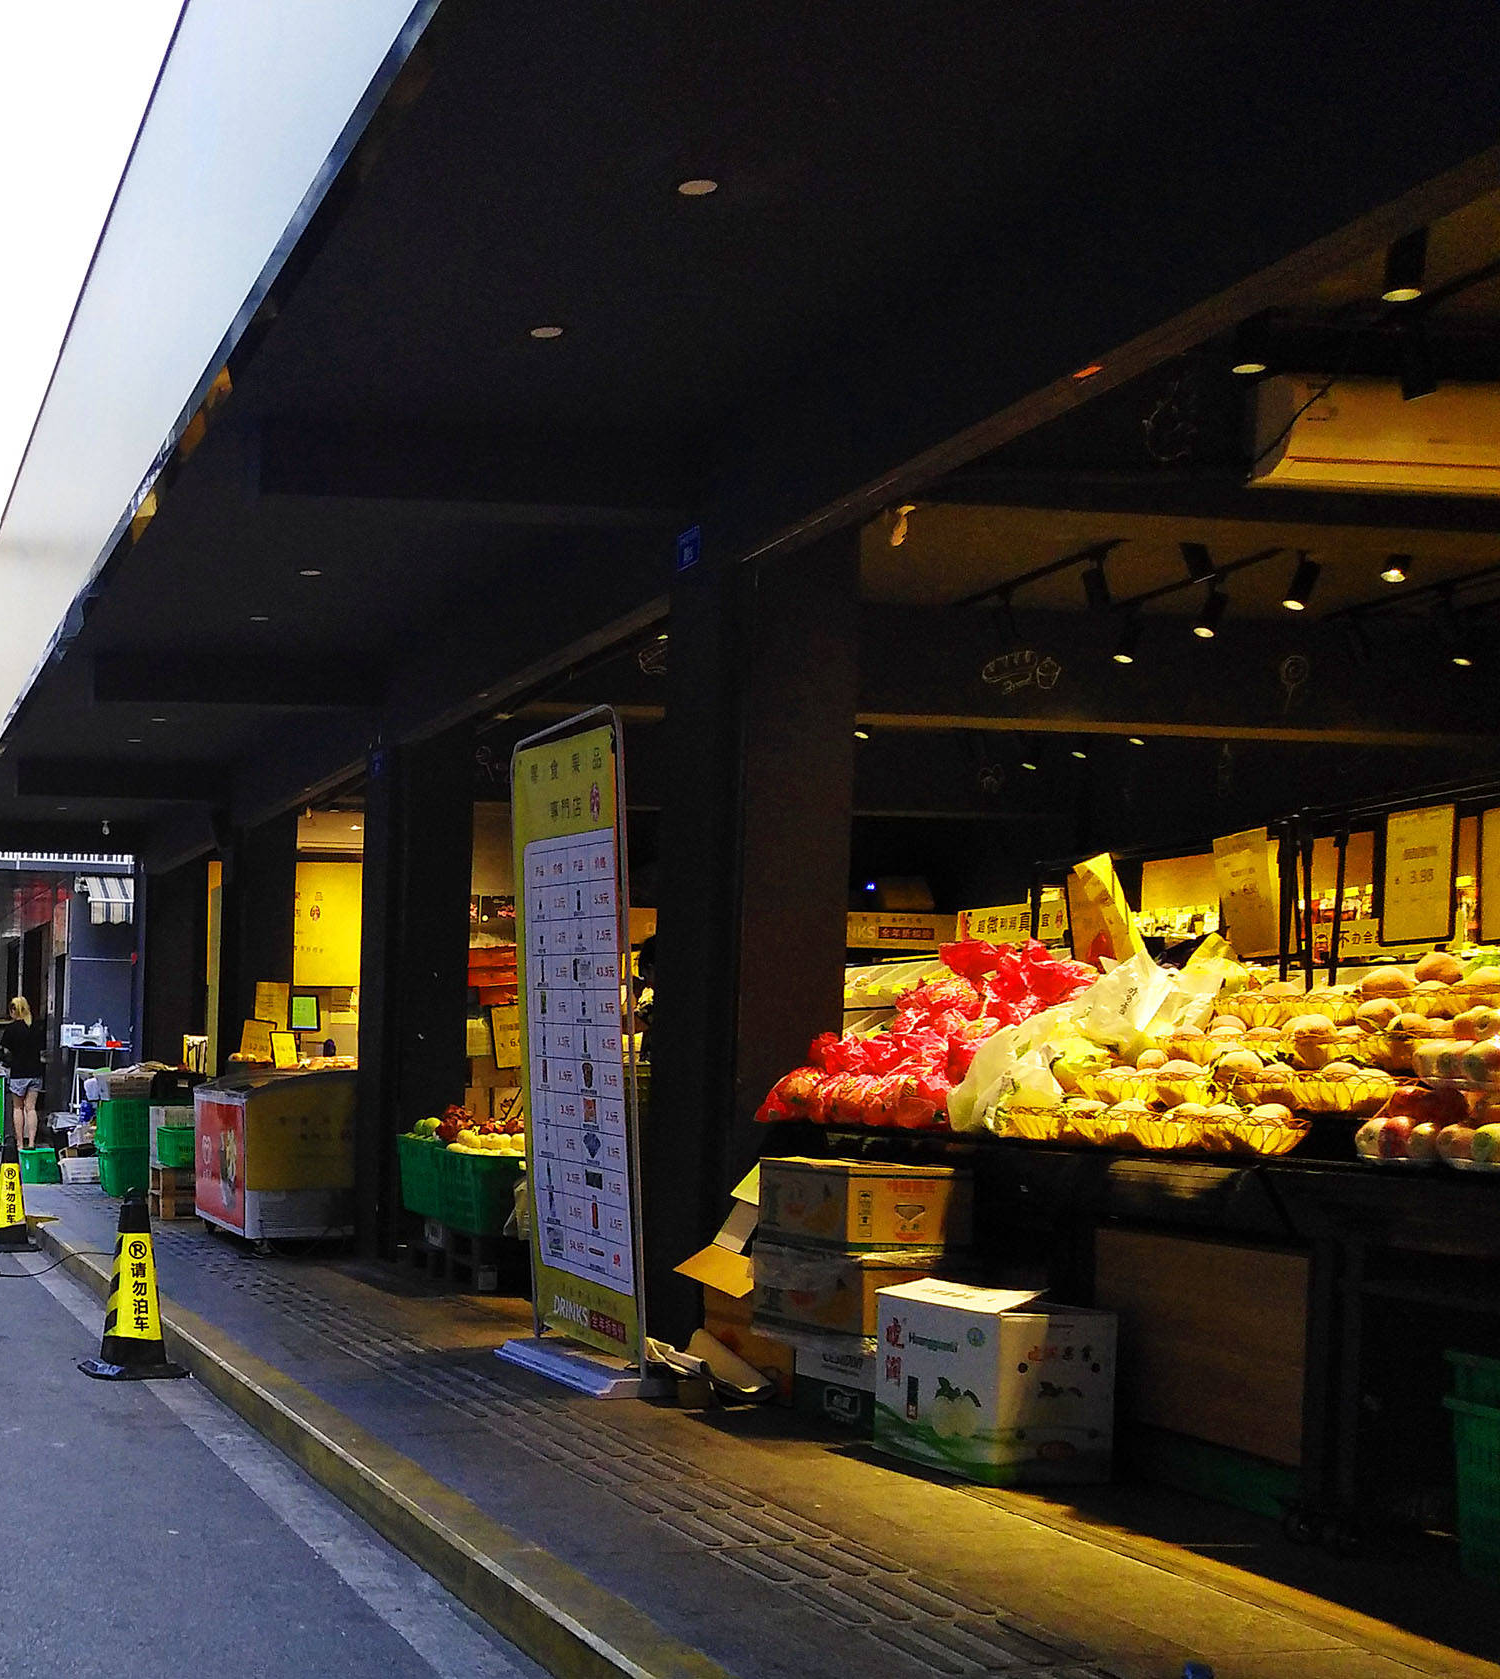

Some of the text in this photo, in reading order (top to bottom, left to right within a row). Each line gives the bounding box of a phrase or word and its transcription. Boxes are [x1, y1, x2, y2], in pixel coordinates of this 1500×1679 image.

[4, 1182, 17, 1224] 请勿泊车
[131, 1261, 150, 1332] 请勿泊车
[553, 1295, 589, 1327] DRINKS
